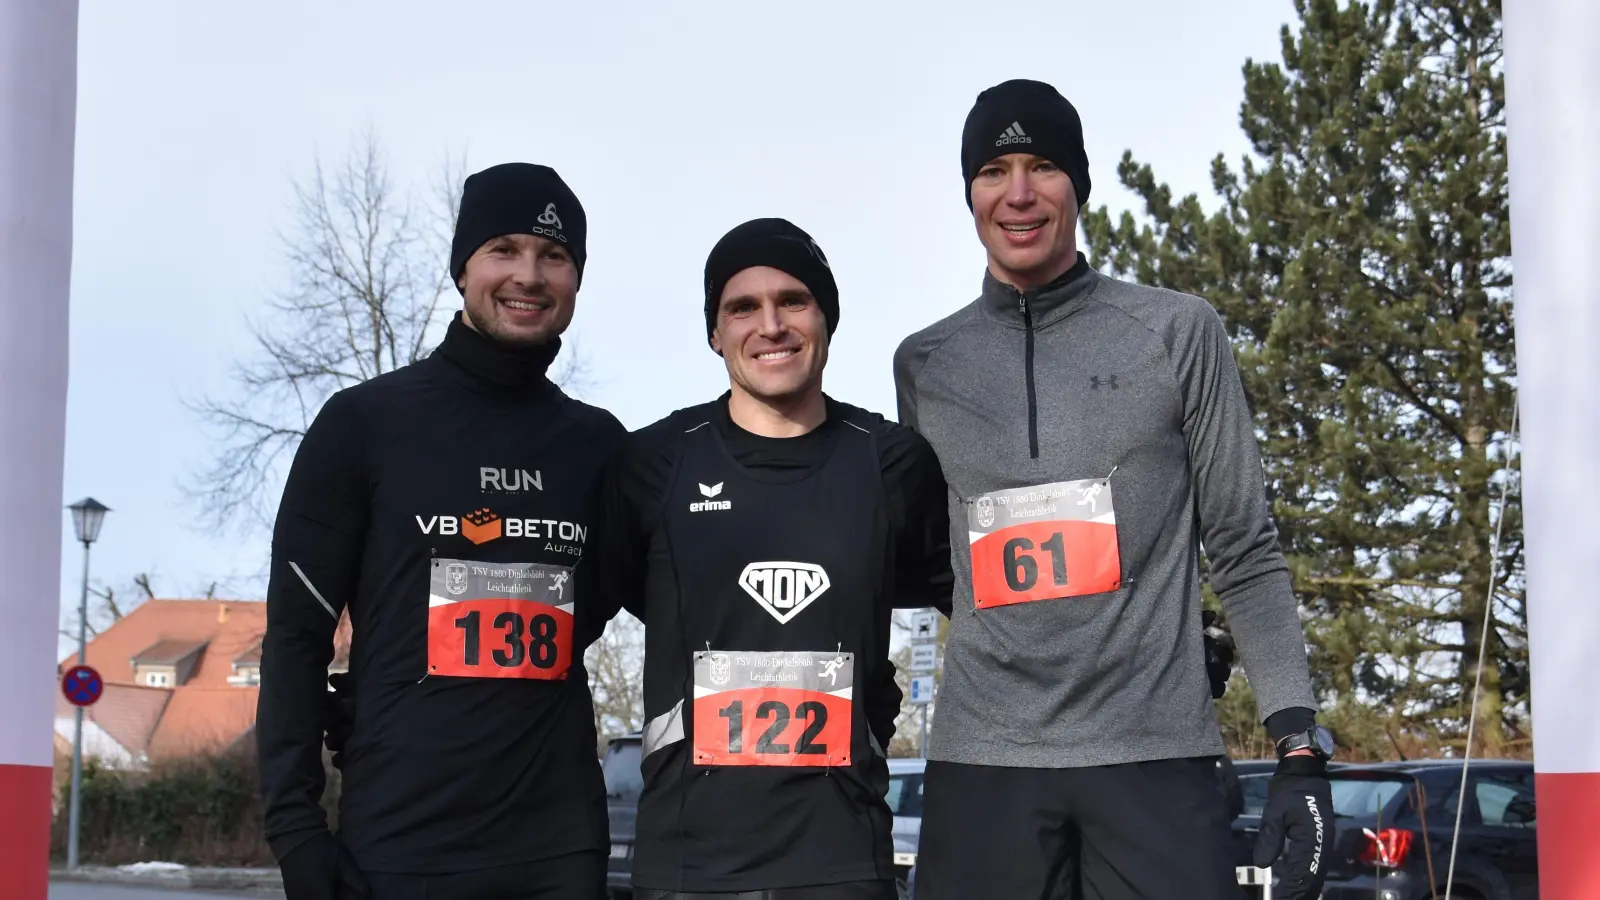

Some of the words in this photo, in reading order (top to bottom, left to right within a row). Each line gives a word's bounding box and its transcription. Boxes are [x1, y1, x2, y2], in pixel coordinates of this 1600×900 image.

[995, 135, 1032, 147] adidas
[532, 226, 567, 243] odlo
[480, 466, 543, 491] RUN
[689, 499, 732, 513] erima
[995, 495, 1010, 505] TSV
[415, 515, 459, 535] VB
[505, 518, 588, 545] BETON
[472, 566, 488, 576] TSV
[490, 569, 507, 578] 1860
[1003, 531, 1068, 593] 61
[486, 581, 533, 593] Leichtathletik
[748, 568, 821, 609] MON
[453, 610, 558, 670] 138
[735, 656, 751, 666] TSV
[718, 699, 828, 755] 122
[1304, 795, 1324, 875] SALOMON
